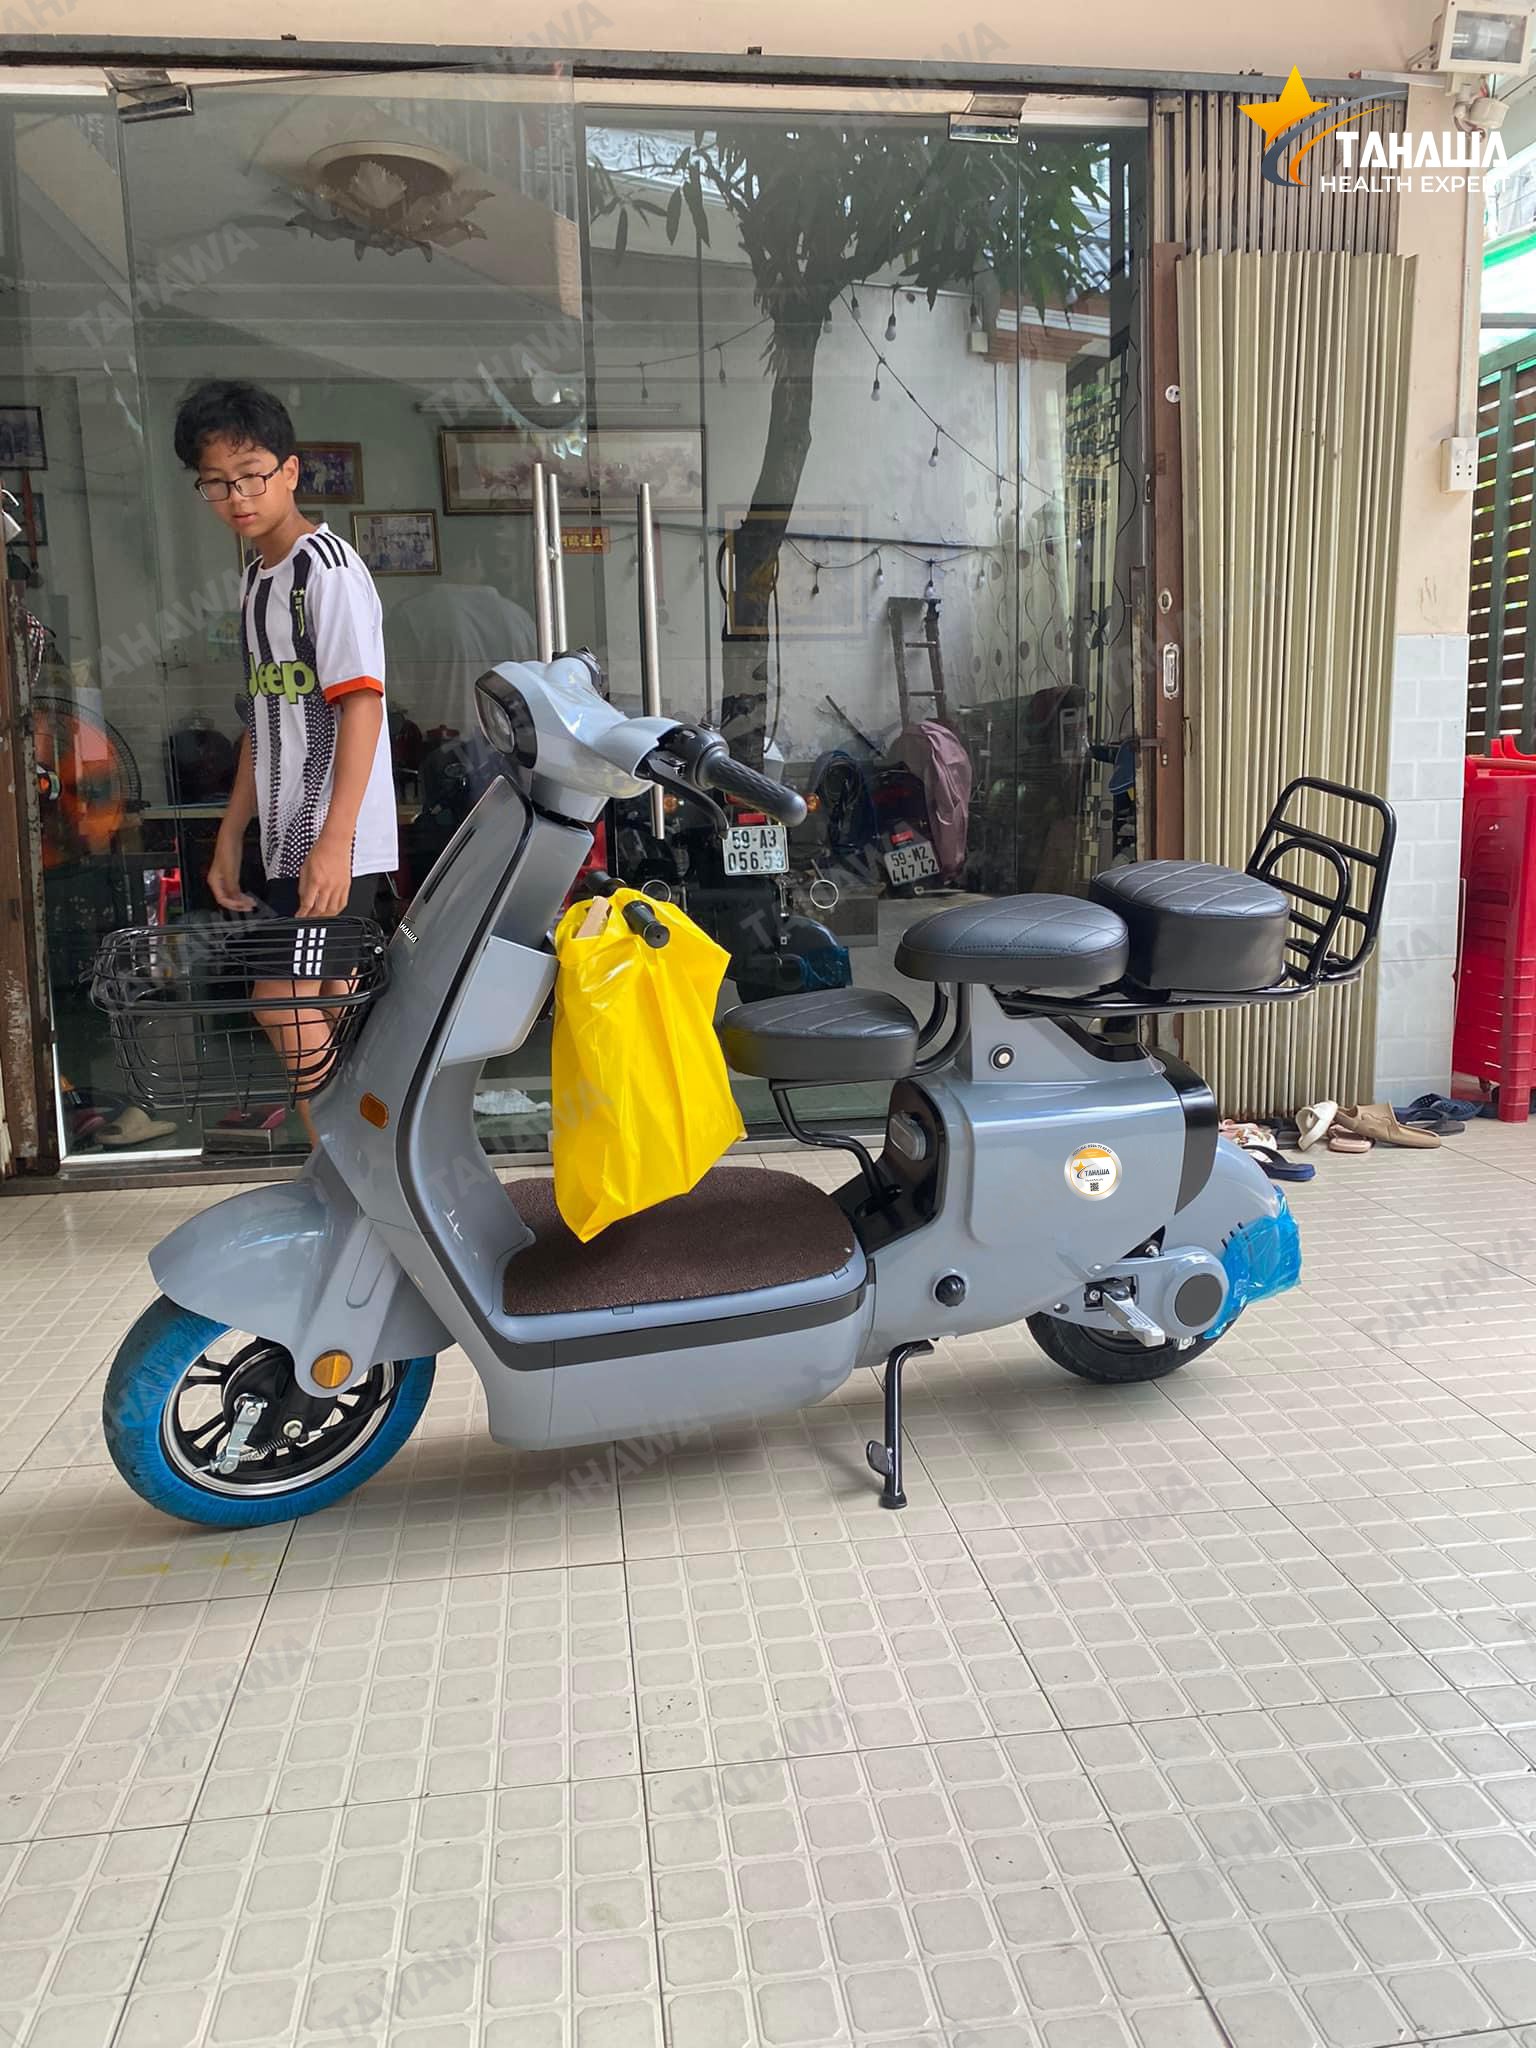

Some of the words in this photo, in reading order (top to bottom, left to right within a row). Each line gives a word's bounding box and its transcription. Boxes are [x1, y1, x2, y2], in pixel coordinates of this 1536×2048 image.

[248, 651, 316, 705] Jeep
[732, 829, 777, 850] 59-A3
[399, 921, 420, 944] HAWA
[1085, 1168, 1110, 1177] TAHAWA
